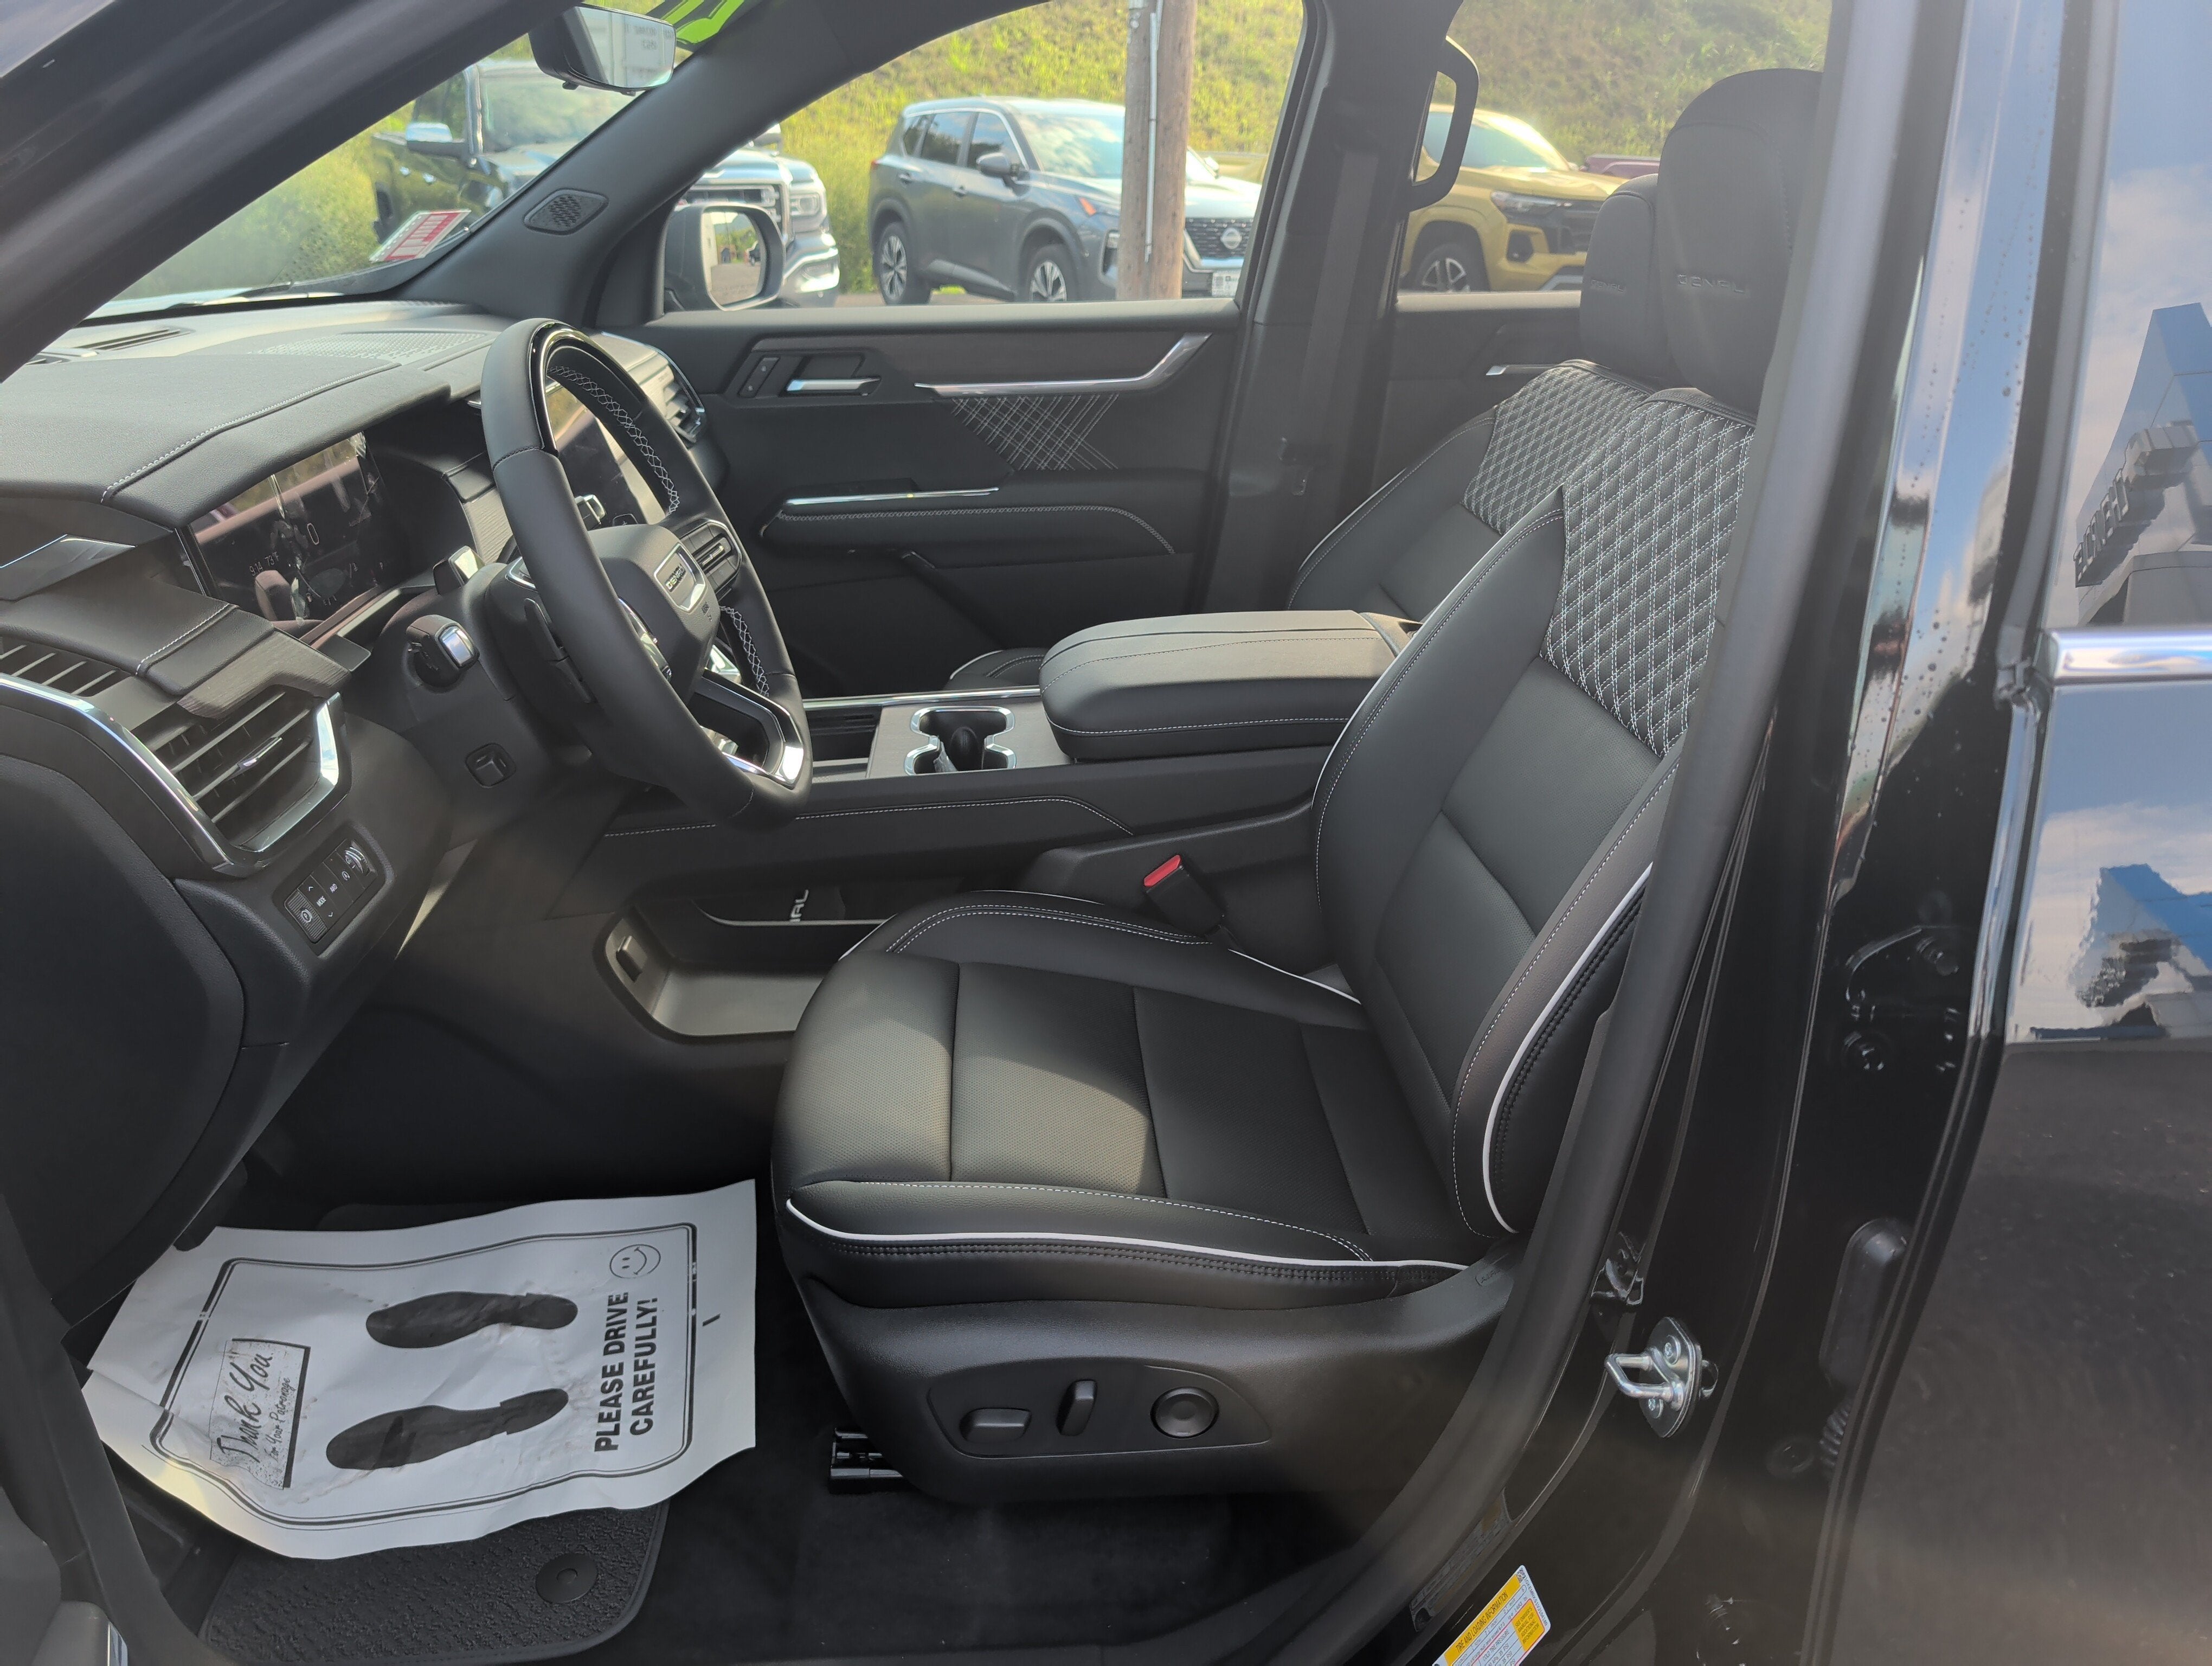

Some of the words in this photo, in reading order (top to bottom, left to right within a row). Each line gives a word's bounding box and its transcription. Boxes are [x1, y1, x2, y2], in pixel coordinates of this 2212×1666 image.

[316, 895, 326, 907] MODE
[603, 1292, 629, 1356] DRIVE
[229, 1353, 273, 1392] You
[629, 1297, 658, 1436] CAREFULLY!
[216, 1394, 262, 1464] Thank
[268, 1377, 296, 1422] Patronage
[594, 1362, 624, 1452] PLEASE
[1456, 1641, 1465, 1654] TIRE
[1464, 1632, 1472, 1646] AND
[1471, 1616, 1487, 1638] LOADING
[1486, 1591, 1509, 1621] INFORMATION
